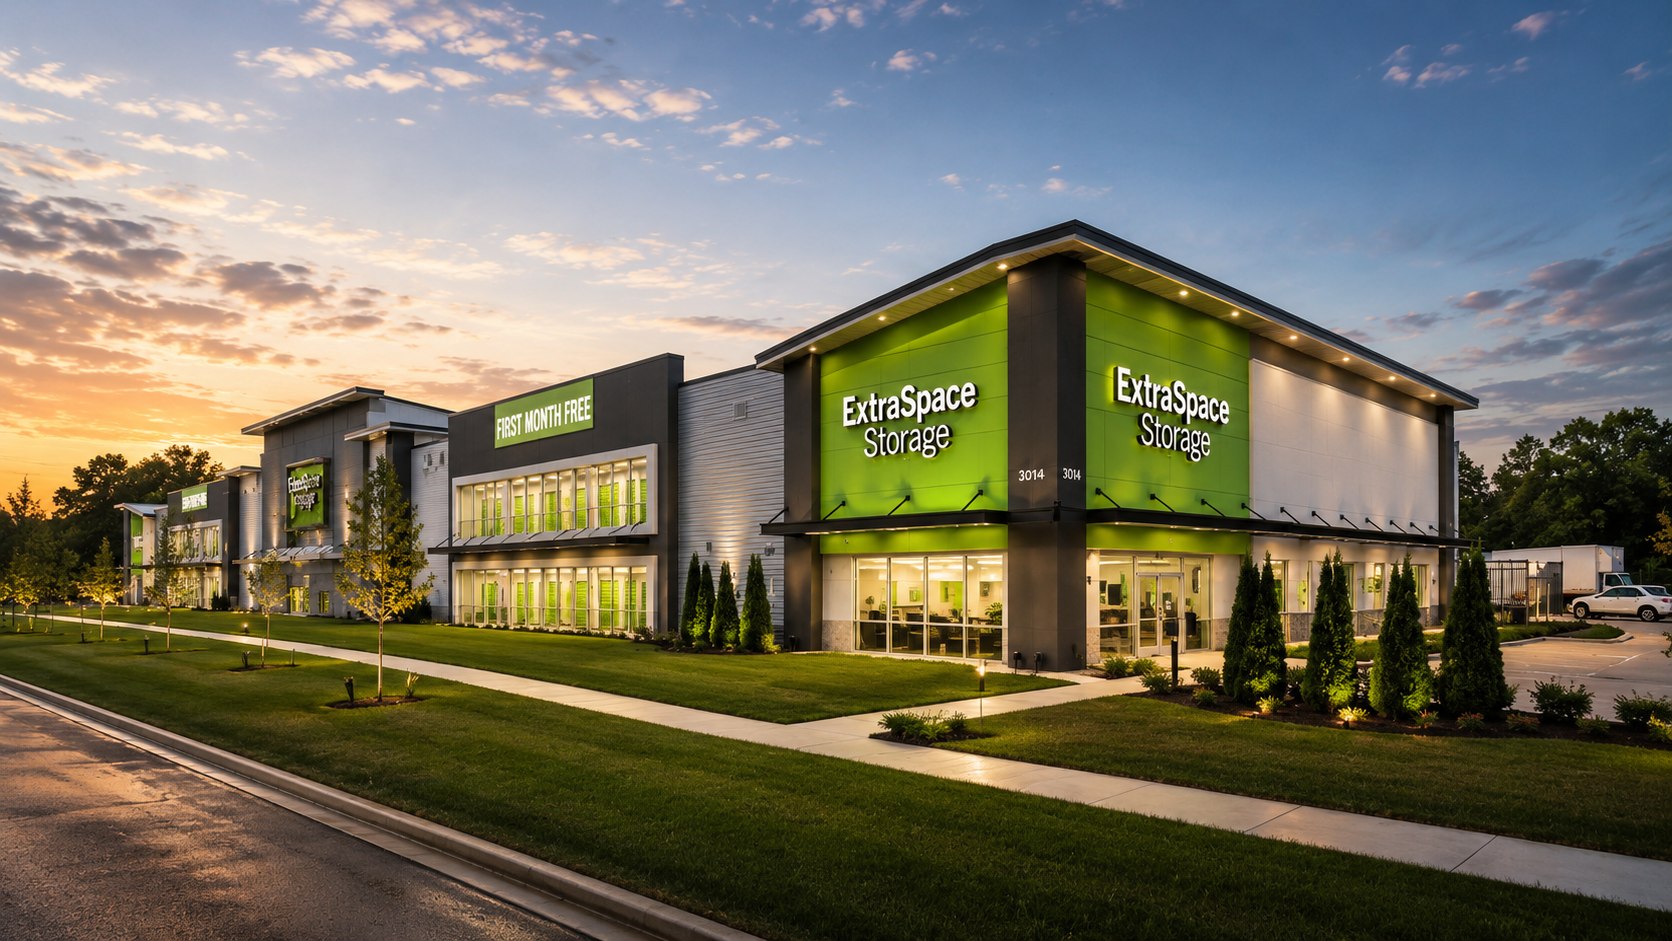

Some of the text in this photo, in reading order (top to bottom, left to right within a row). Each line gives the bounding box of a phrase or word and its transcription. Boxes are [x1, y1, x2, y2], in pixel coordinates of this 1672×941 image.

[497, 395, 591, 440] FIRST MONTH FREE
[843, 382, 976, 427] ExtraSpace
[1117, 366, 1230, 425] ExtraSpace
[864, 424, 950, 459] Storage
[1140, 412, 1211, 462] Storage
[1018, 468, 1045, 482] 3014
[1062, 467, 1082, 481] 3014
